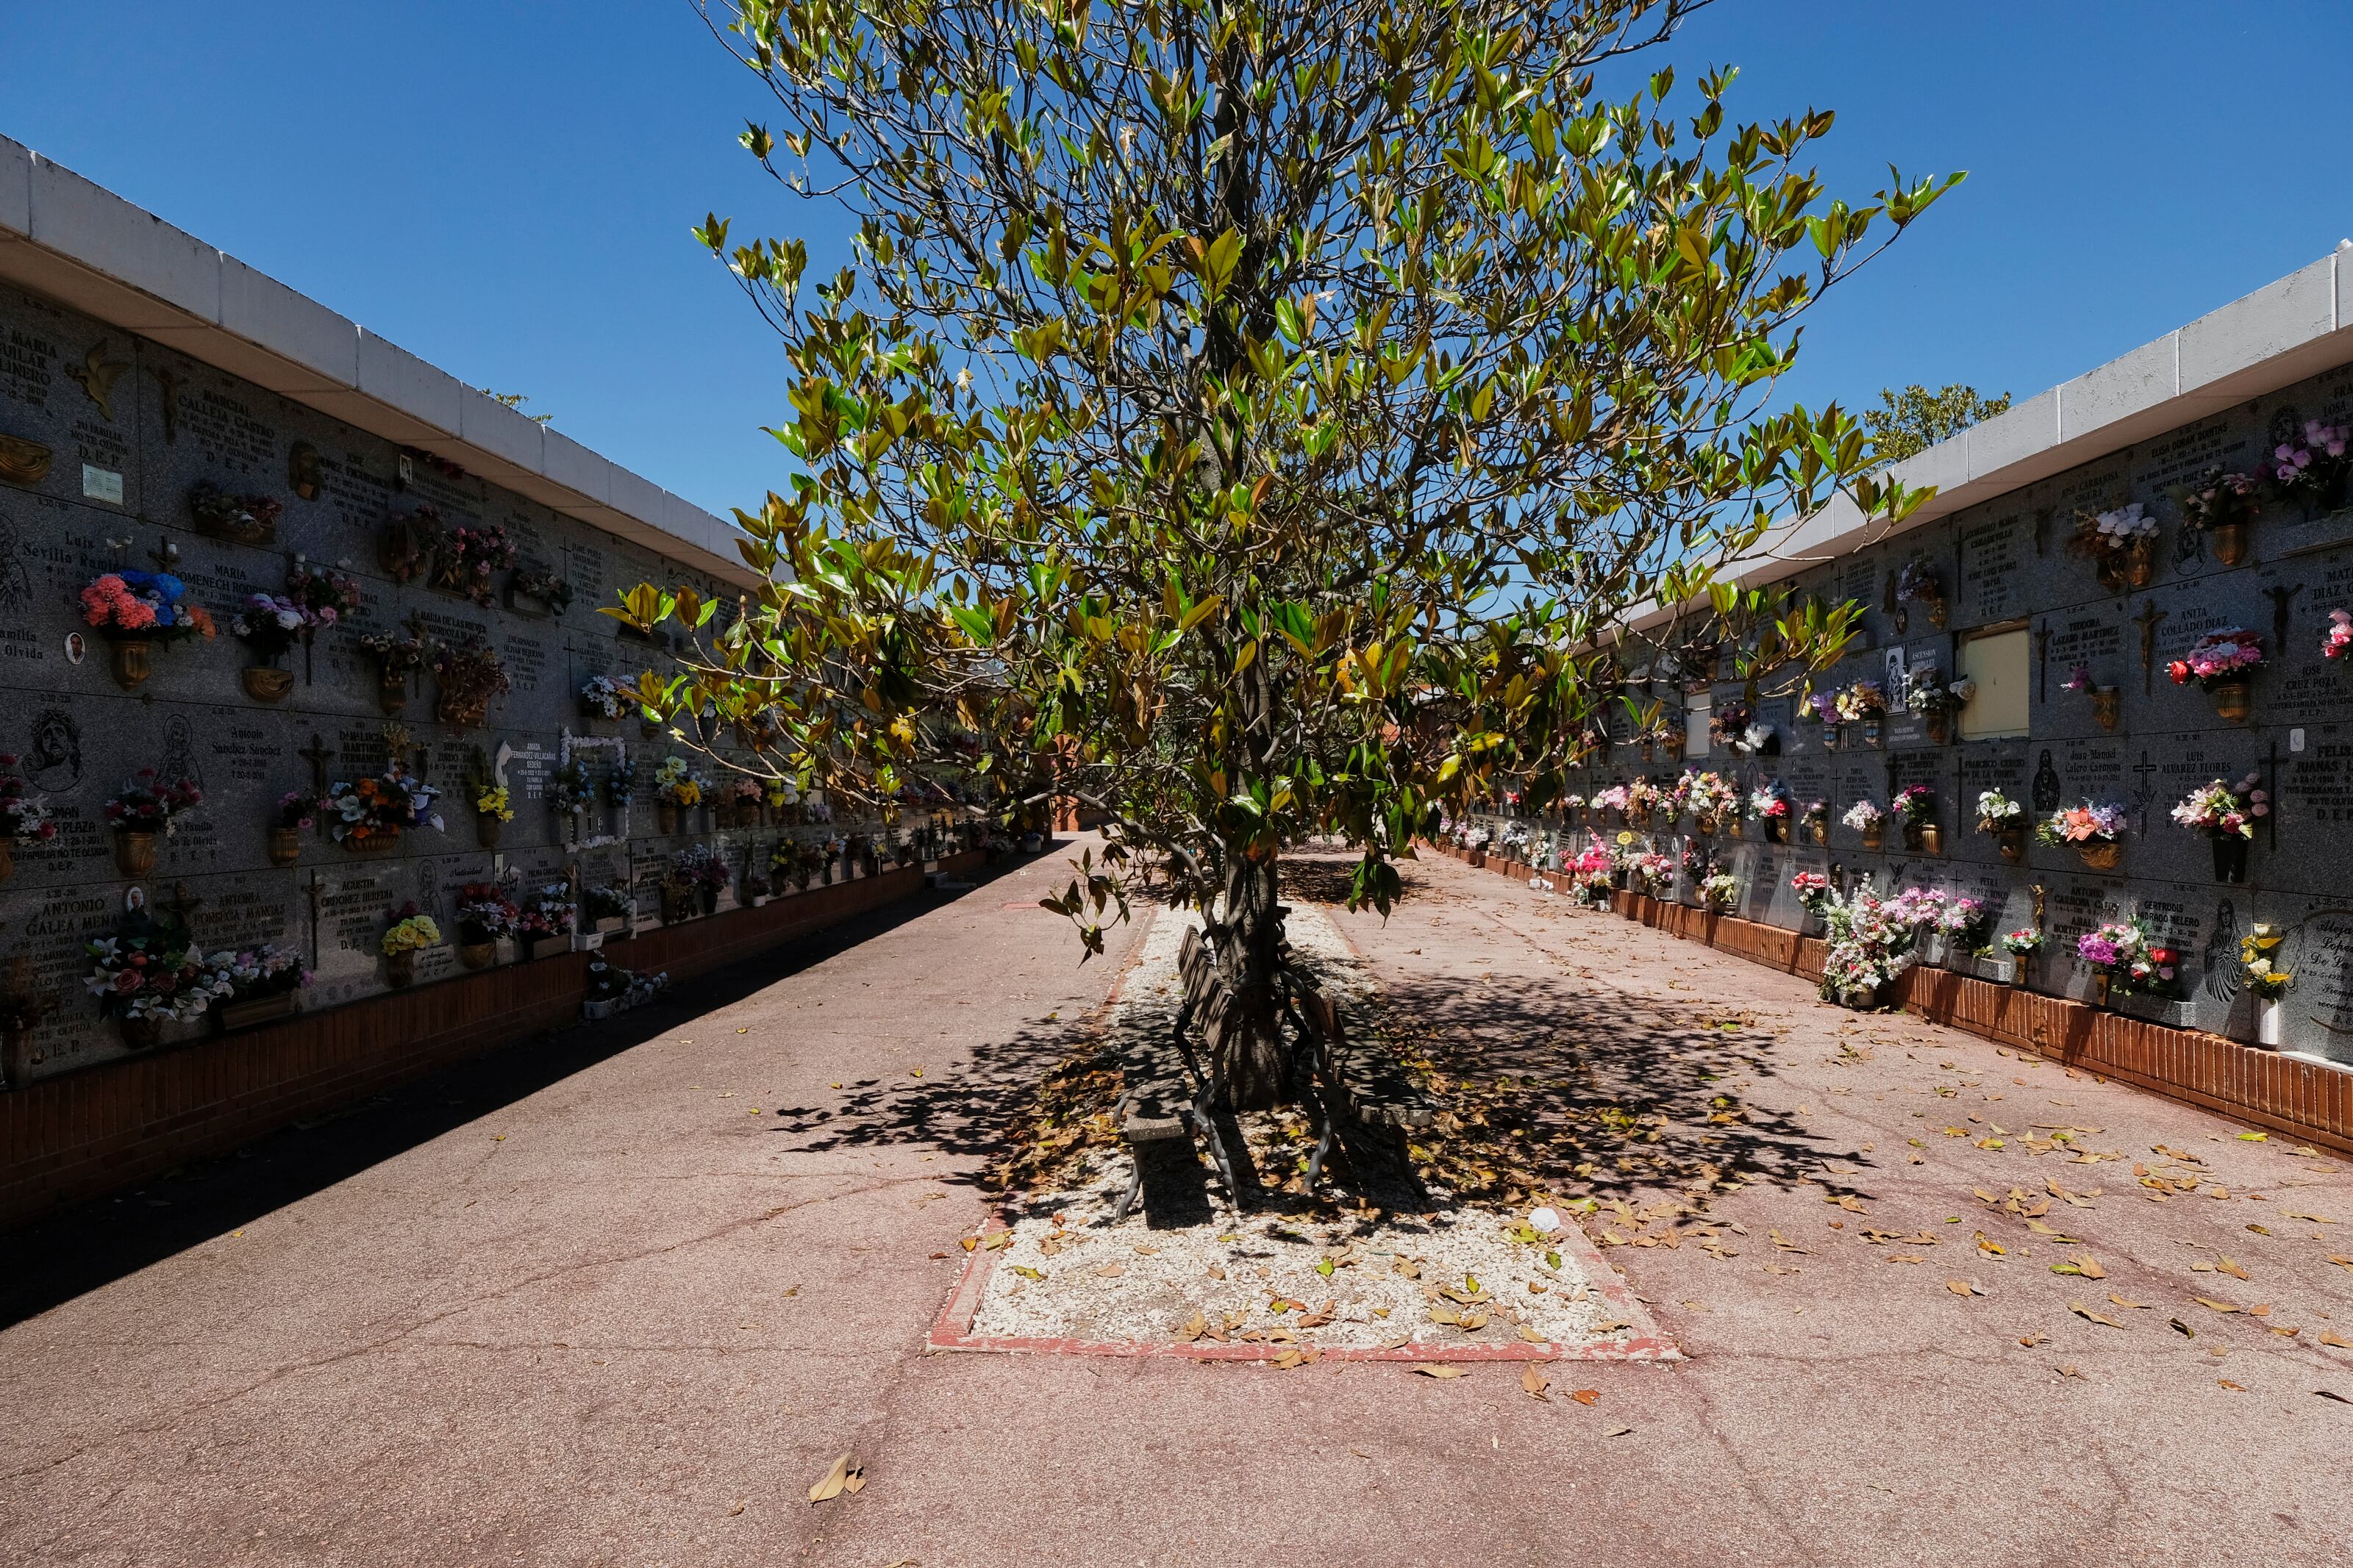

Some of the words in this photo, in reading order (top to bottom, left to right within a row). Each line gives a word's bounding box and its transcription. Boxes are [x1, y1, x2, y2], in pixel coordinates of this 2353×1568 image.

[12, 330, 58, 359] MARIA
[204, 390, 249, 416] MARCIAL
[2324, 400, 2346, 417] LOSA
[71, 429, 84, 441] NO
[90, 423, 123, 443] FAMILIA
[2152, 445, 2170, 459] ELISA
[2171, 435, 2196, 451] DORAN
[2197, 422, 2228, 442] QUINTAS
[2182, 470, 2199, 484] RUIZ
[65, 531, 94, 549] Luis
[23, 542, 72, 564] Sevilla
[215, 564, 246, 580] MARIA
[172, 570, 229, 591] DOMENECH
[2313, 585, 2341, 601] DIAZ
[2181, 607, 2207, 622] ANITA
[2068, 618, 2101, 632] TEODORA
[2160, 620, 2203, 637] COLLADO
[2205, 615, 2229, 630] DIAZ
[2082, 626, 2120, 642] MARTINEZ
[5, 644, 43, 659] Olvida
[2302, 665, 2322, 677] JOSE
[2286, 679, 2309, 691] CRUZ
[2313, 676, 2337, 689] POZA
[231, 726, 264, 740] Antonio
[212, 741, 246, 756] Sanchez
[249, 744, 281, 756] Sanchez
[2070, 750, 2087, 761] Juan
[2090, 747, 2115, 760] Manuel
[339, 753, 389, 765] FERNANDEZ
[2186, 751, 2204, 762] LUIS
[2065, 762, 2088, 773] Calero
[2090, 762, 2121, 773] Carmona
[2161, 763, 2196, 774] ALVAREZ
[2199, 762, 2231, 773] FLORES
[2296, 762, 2338, 773] JUANAS
[63, 821, 96, 834] PLAZA
[22, 849, 55, 860] FAMILIA
[57, 848, 69, 859] NO
[71, 848, 81, 858] TE
[82, 846, 110, 857] OLVIDA
[342, 878, 376, 892] AGUSTIN
[1980, 876, 1999, 888] PETRA
[218, 892, 262, 908] ANTONIA
[321, 892, 360, 907] ORDOÑEZ
[1971, 887, 1988, 898] PEREZ
[2071, 887, 2104, 898] ANTONIO
[43, 898, 105, 917] ANTONIO
[2054, 894, 2090, 908] CARMONA
[2144, 901, 2184, 913] GERTRUDIS
[82, 914, 118, 930] MENA
[193, 910, 240, 926] FONSECA
[246, 904, 285, 920] MANGAS
[2171, 914, 2200, 928] MELERO
[2310, 952, 2329, 967] De
